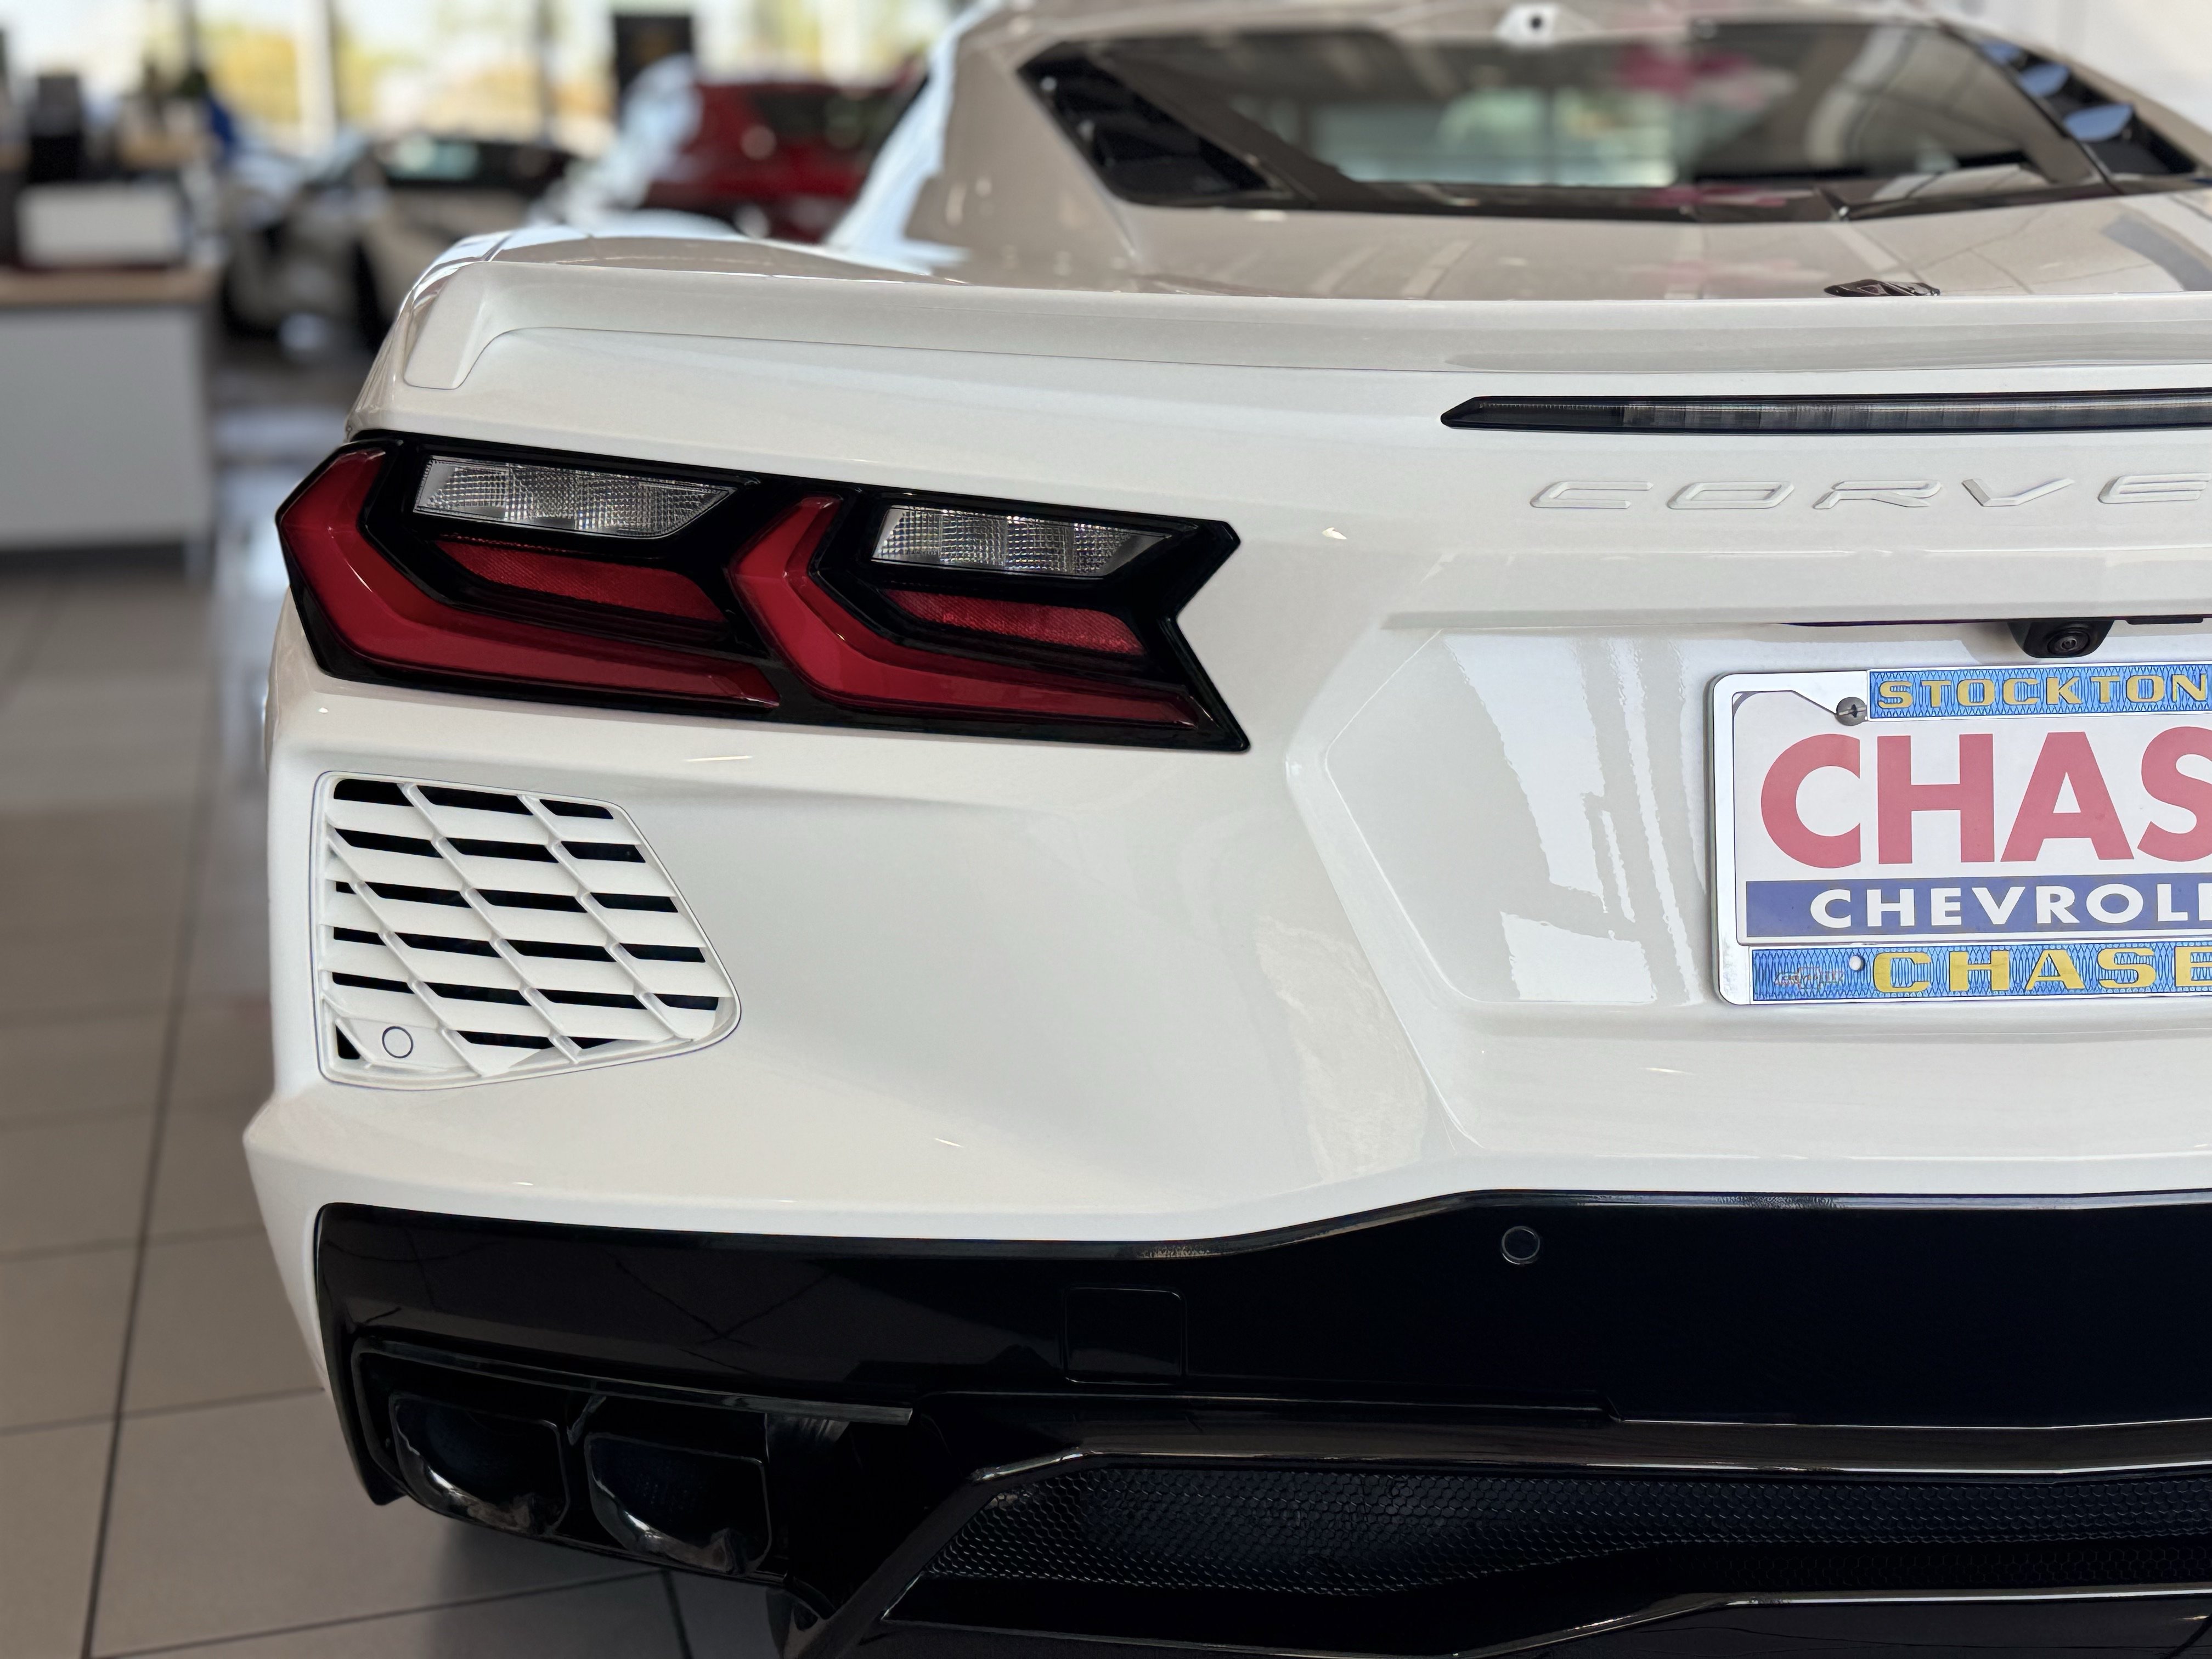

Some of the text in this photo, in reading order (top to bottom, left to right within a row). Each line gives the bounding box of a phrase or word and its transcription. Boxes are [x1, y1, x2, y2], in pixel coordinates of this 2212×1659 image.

[1530, 473, 2211, 510] CORVE
[1878, 673, 2207, 710] STOCKTON
[1761, 726, 2212, 868] CHAS
[1872, 946, 2212, 993] CHASE
